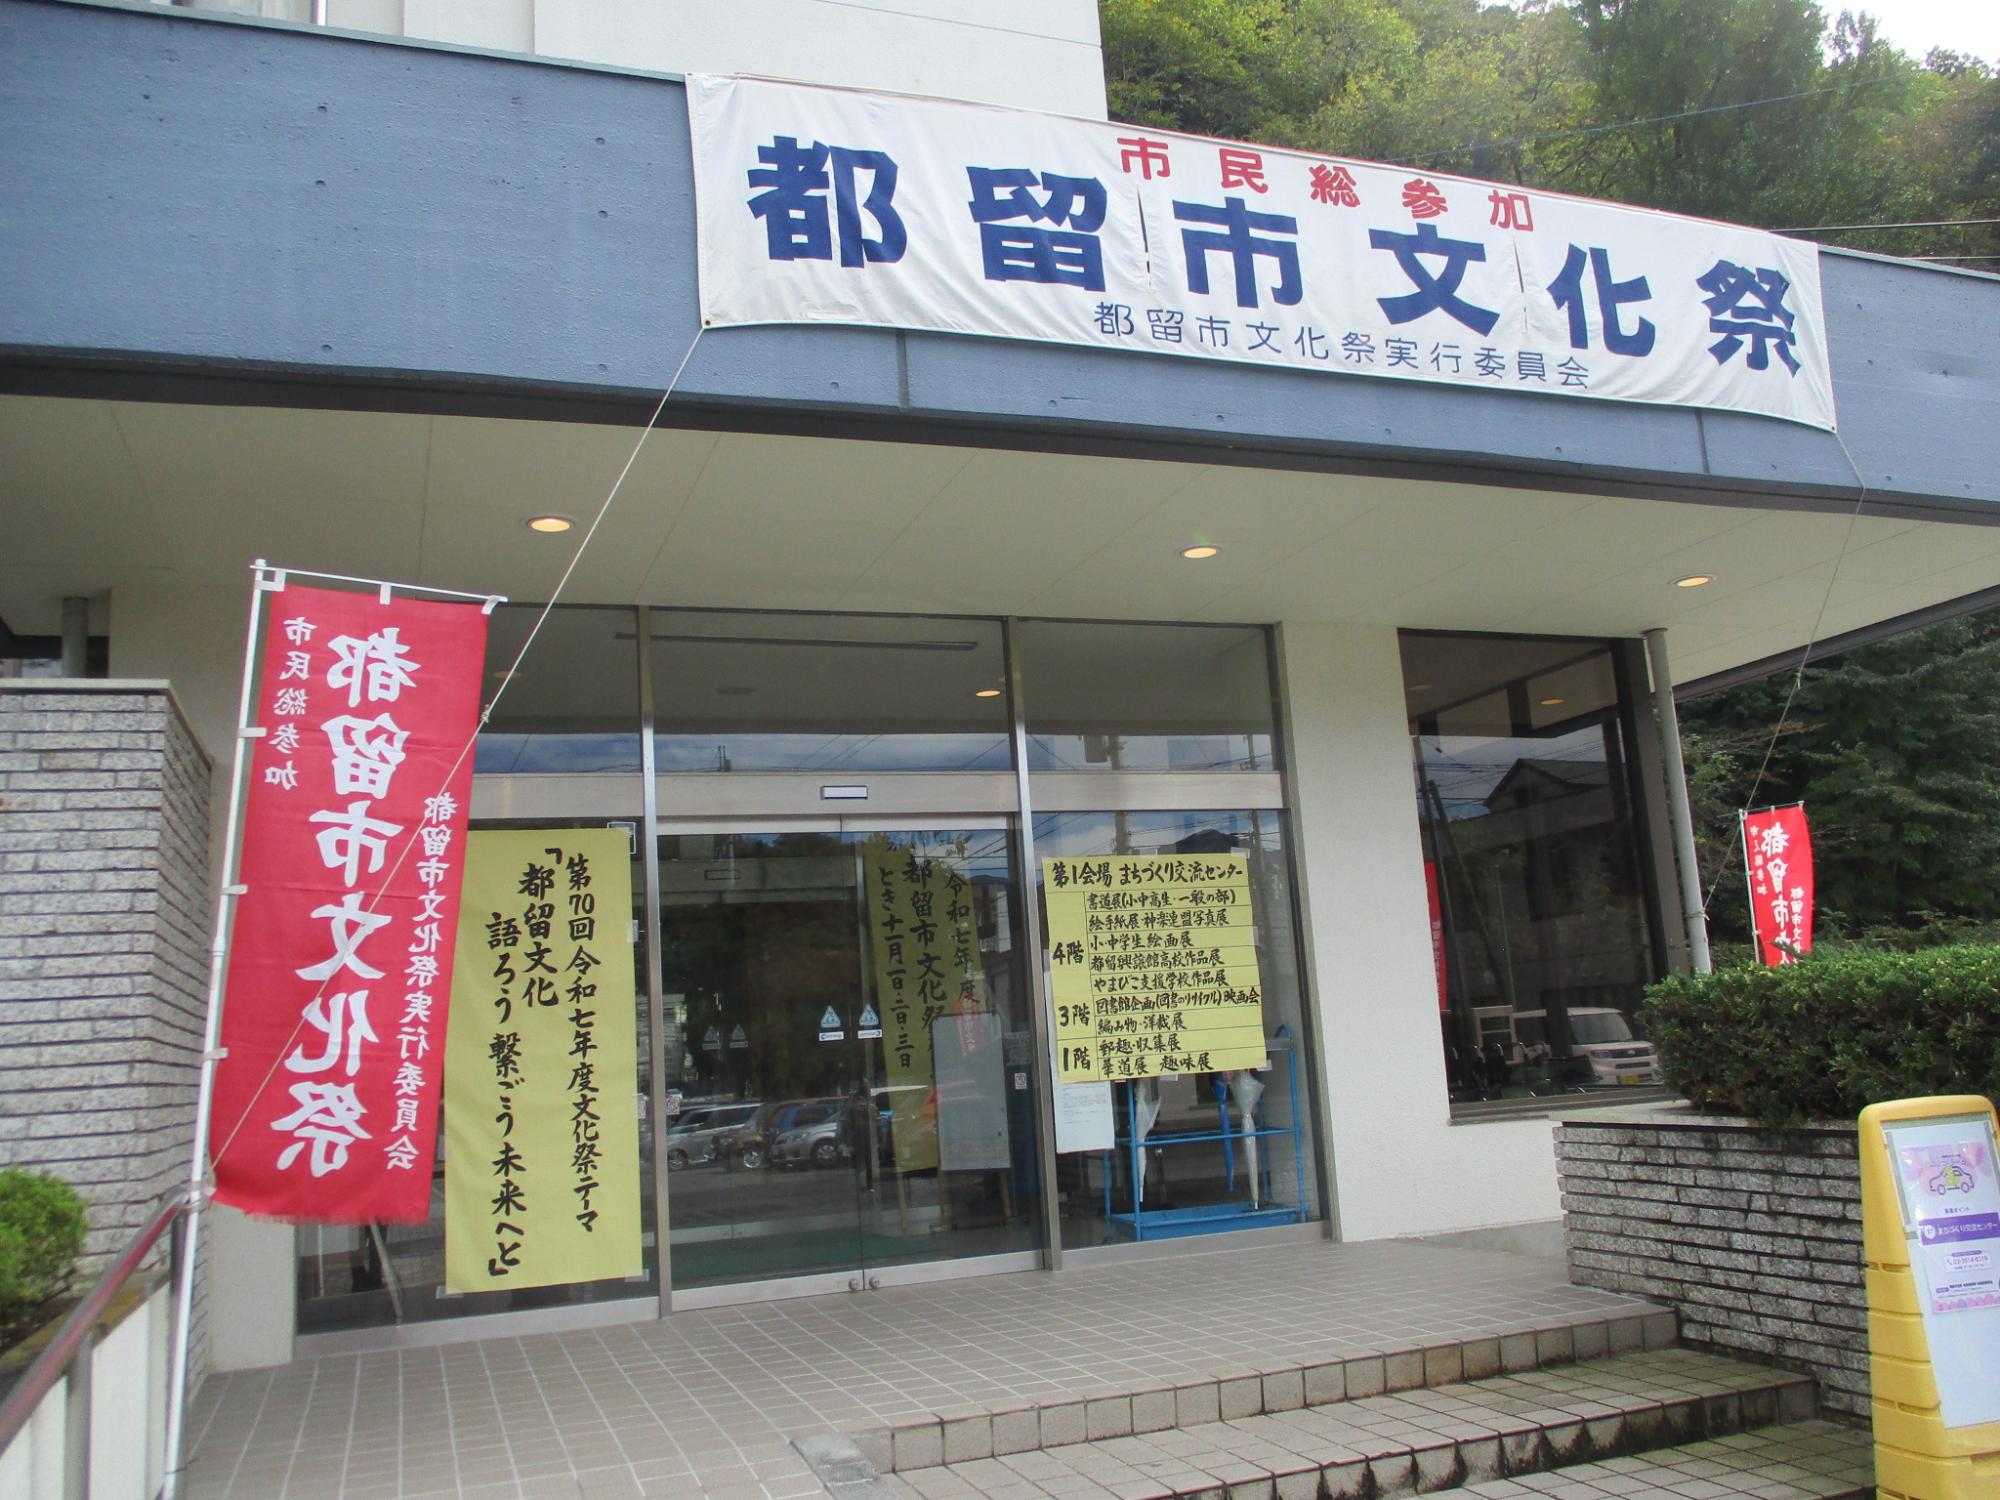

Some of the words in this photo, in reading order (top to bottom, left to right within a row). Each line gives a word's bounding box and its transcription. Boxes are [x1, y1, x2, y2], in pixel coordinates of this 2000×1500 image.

[1117, 137, 1534, 232] 市民総参加
[746, 135, 1801, 378] 都留市文化祭
[1093, 302, 1590, 389] 都留市文化祭実行委員会
[1119, 860, 1243, 886] まちづくり交流センター
[1053, 940, 1085, 965] 4階
[1094, 969, 1229, 993] やまびこ支援学校作品展
[1058, 1003, 1091, 1026] 3階
[1063, 1046, 1091, 1071] 1階
